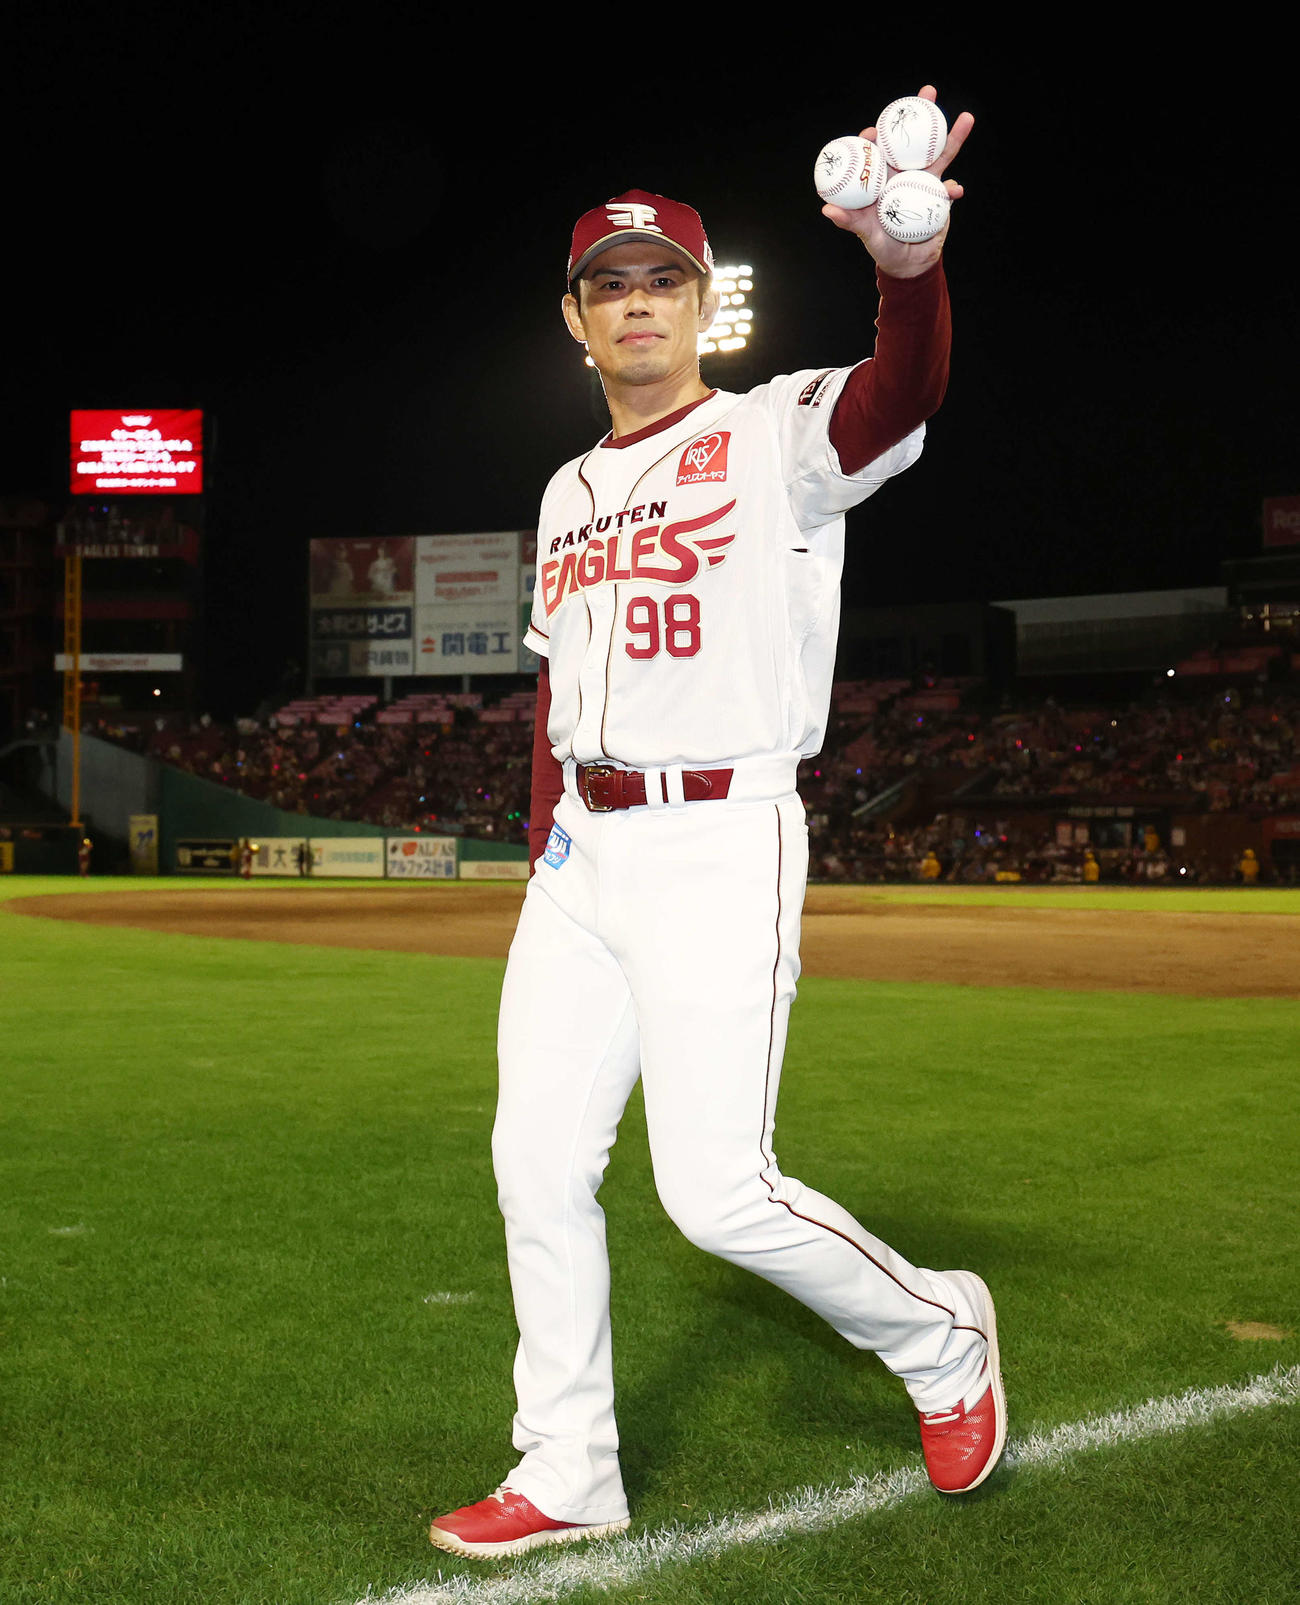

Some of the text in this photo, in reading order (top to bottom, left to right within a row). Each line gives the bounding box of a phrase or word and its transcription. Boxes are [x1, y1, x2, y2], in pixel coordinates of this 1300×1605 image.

[677, 471, 725, 484] アイリスオーヤマ
[541, 498, 737, 618] EAGLES
[550, 501, 668, 555] RAKUTEN
[625, 593, 702, 660] 98
